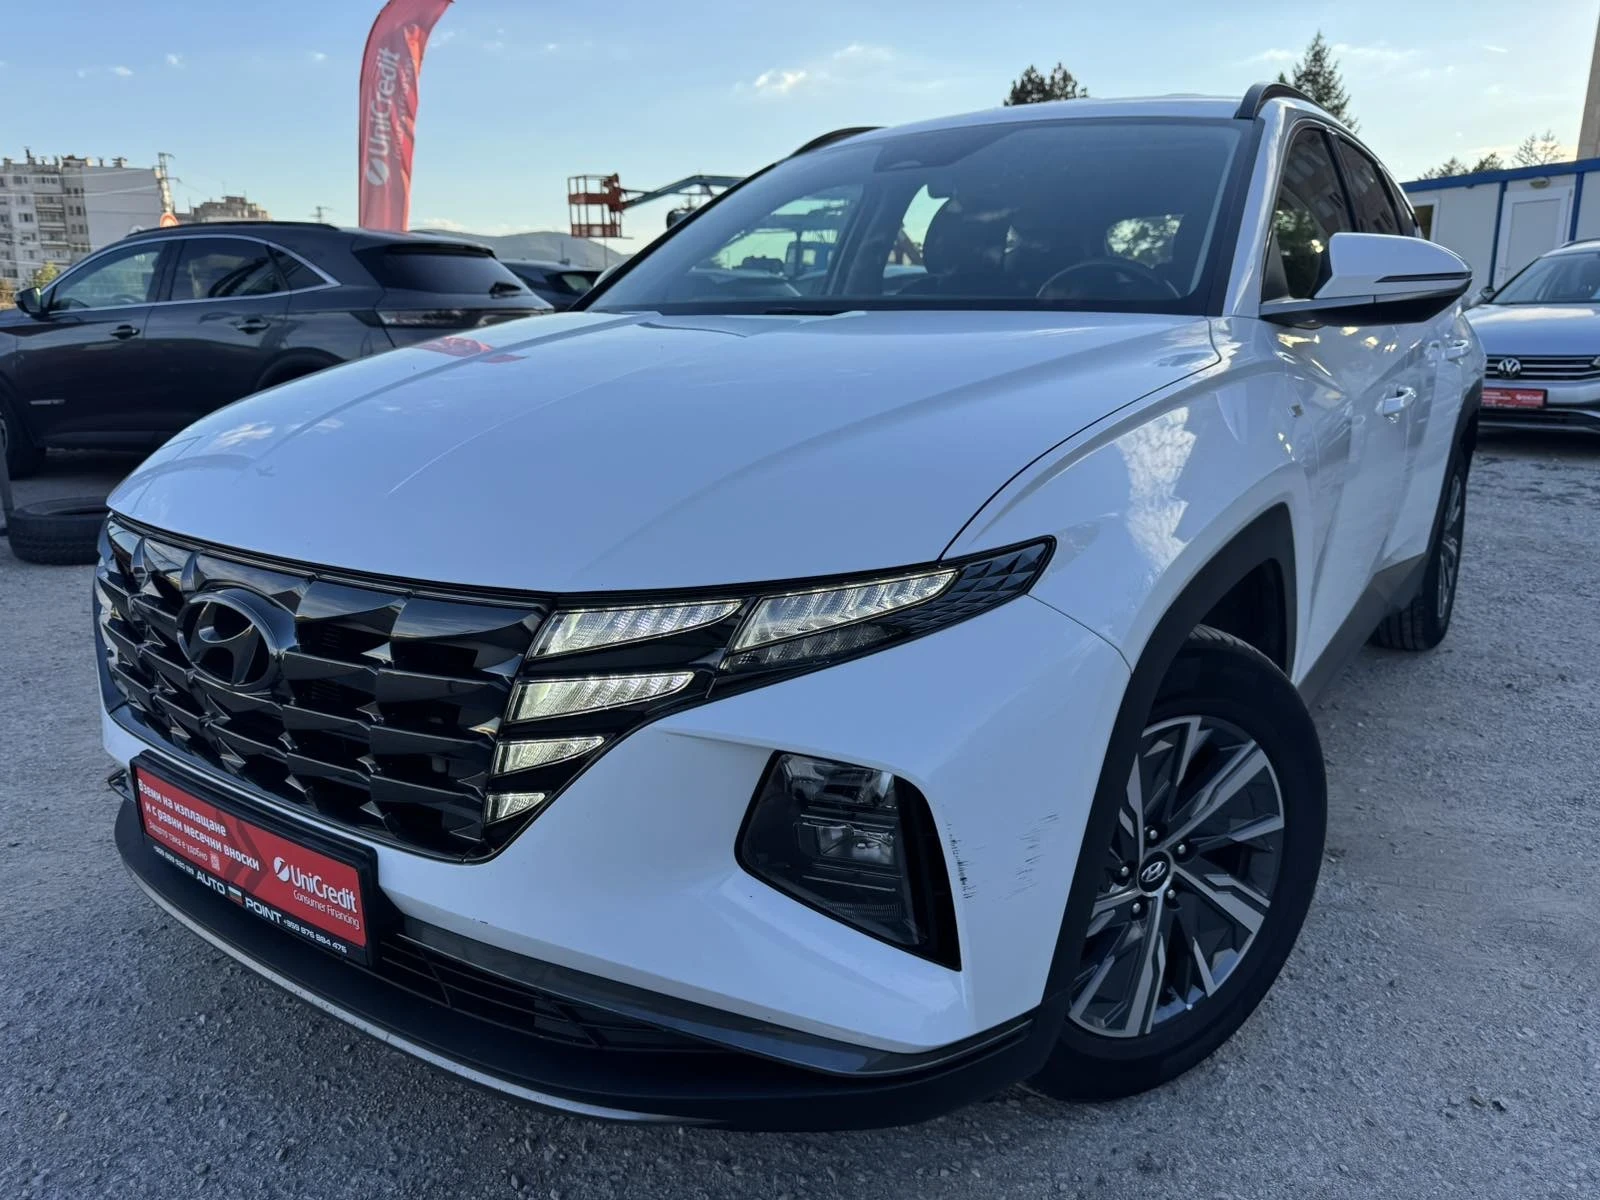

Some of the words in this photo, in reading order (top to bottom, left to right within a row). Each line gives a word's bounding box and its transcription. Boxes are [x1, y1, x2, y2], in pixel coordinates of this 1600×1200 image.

[369, 47, 401, 157] UniCredit
[157, 809, 183, 832] равни
[183, 823, 222, 852] месечни
[223, 844, 260, 872] вноски
[162, 795, 174, 809] на
[174, 801, 227, 837] изплащане
[197, 870, 226, 895] AUTO
[245, 896, 282, 924] POINT
[290, 864, 357, 913] UniCredit
[293, 889, 326, 912] Consumer
[327, 904, 360, 931] Financing
